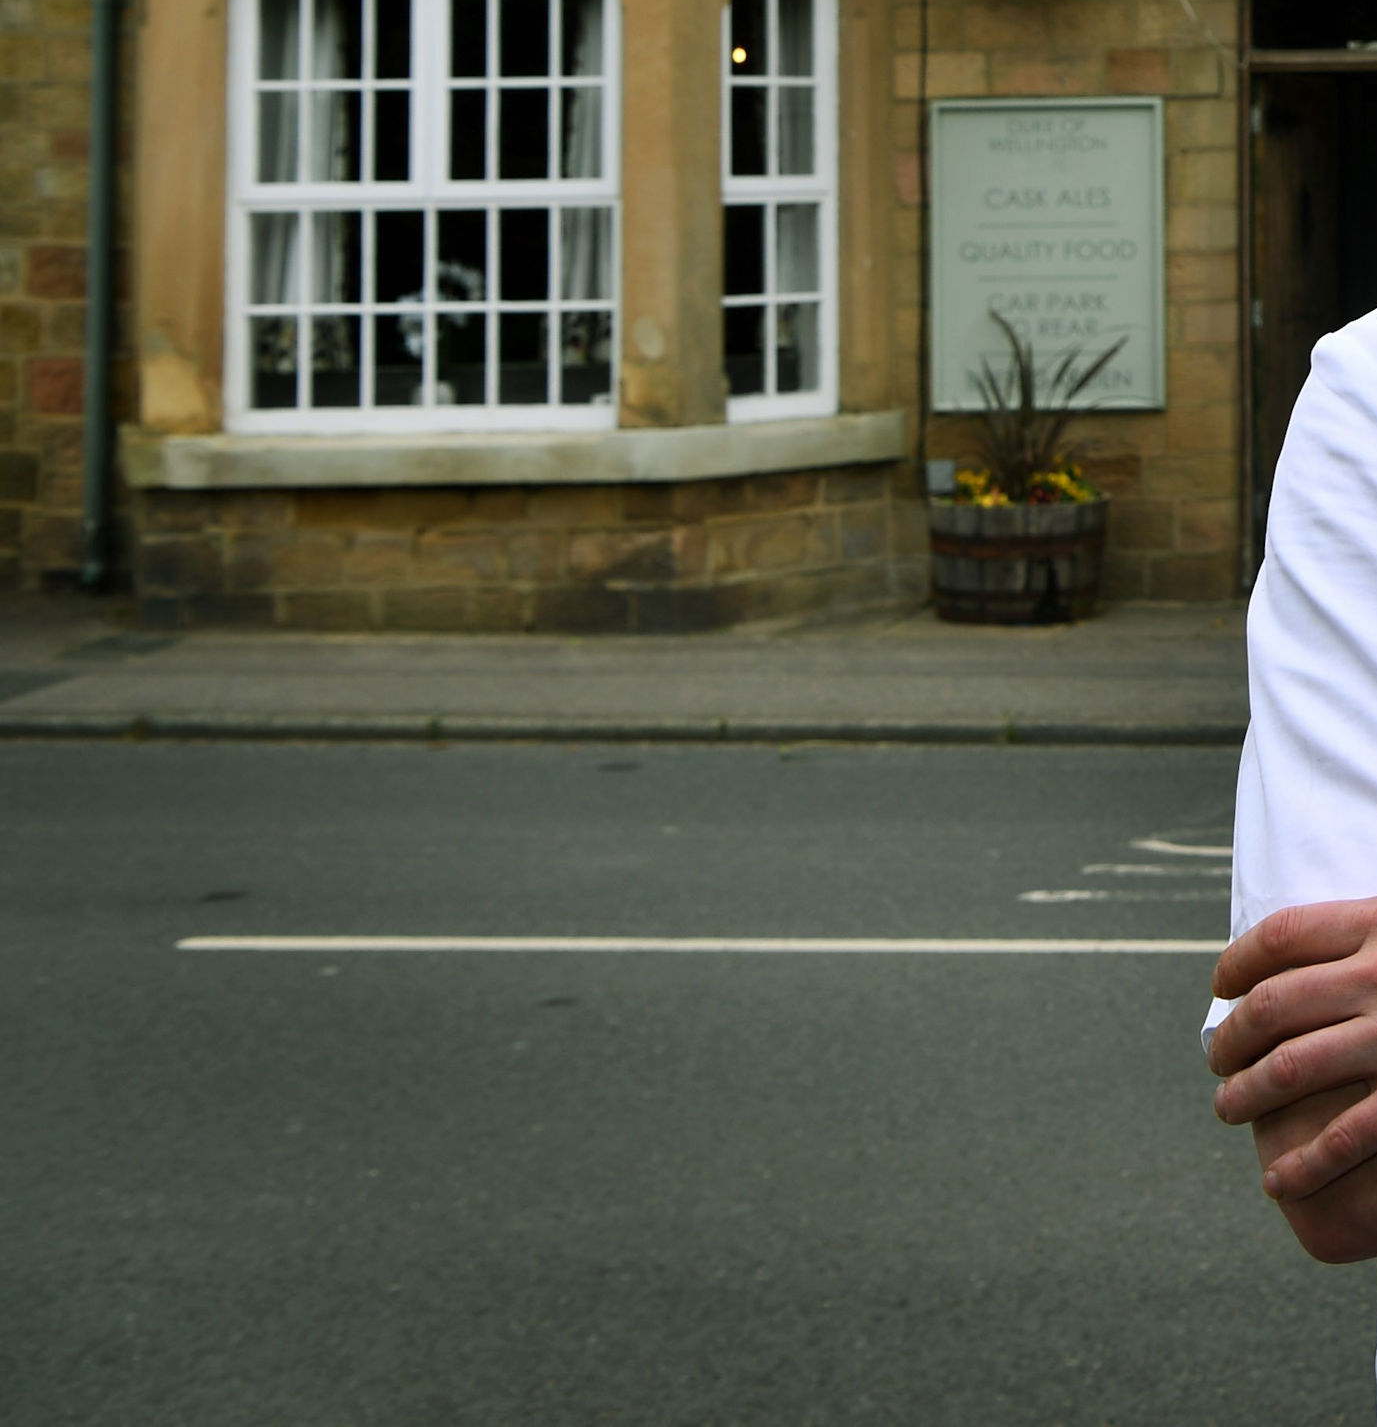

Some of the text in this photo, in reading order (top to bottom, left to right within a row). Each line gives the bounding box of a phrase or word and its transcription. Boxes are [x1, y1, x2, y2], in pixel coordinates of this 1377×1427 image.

[984, 186, 1112, 210] CASK ALES
[959, 239, 1139, 262] QUALITY FOOD
[1045, 291, 1108, 310] PARK
[1038, 317, 1099, 335] REAR
